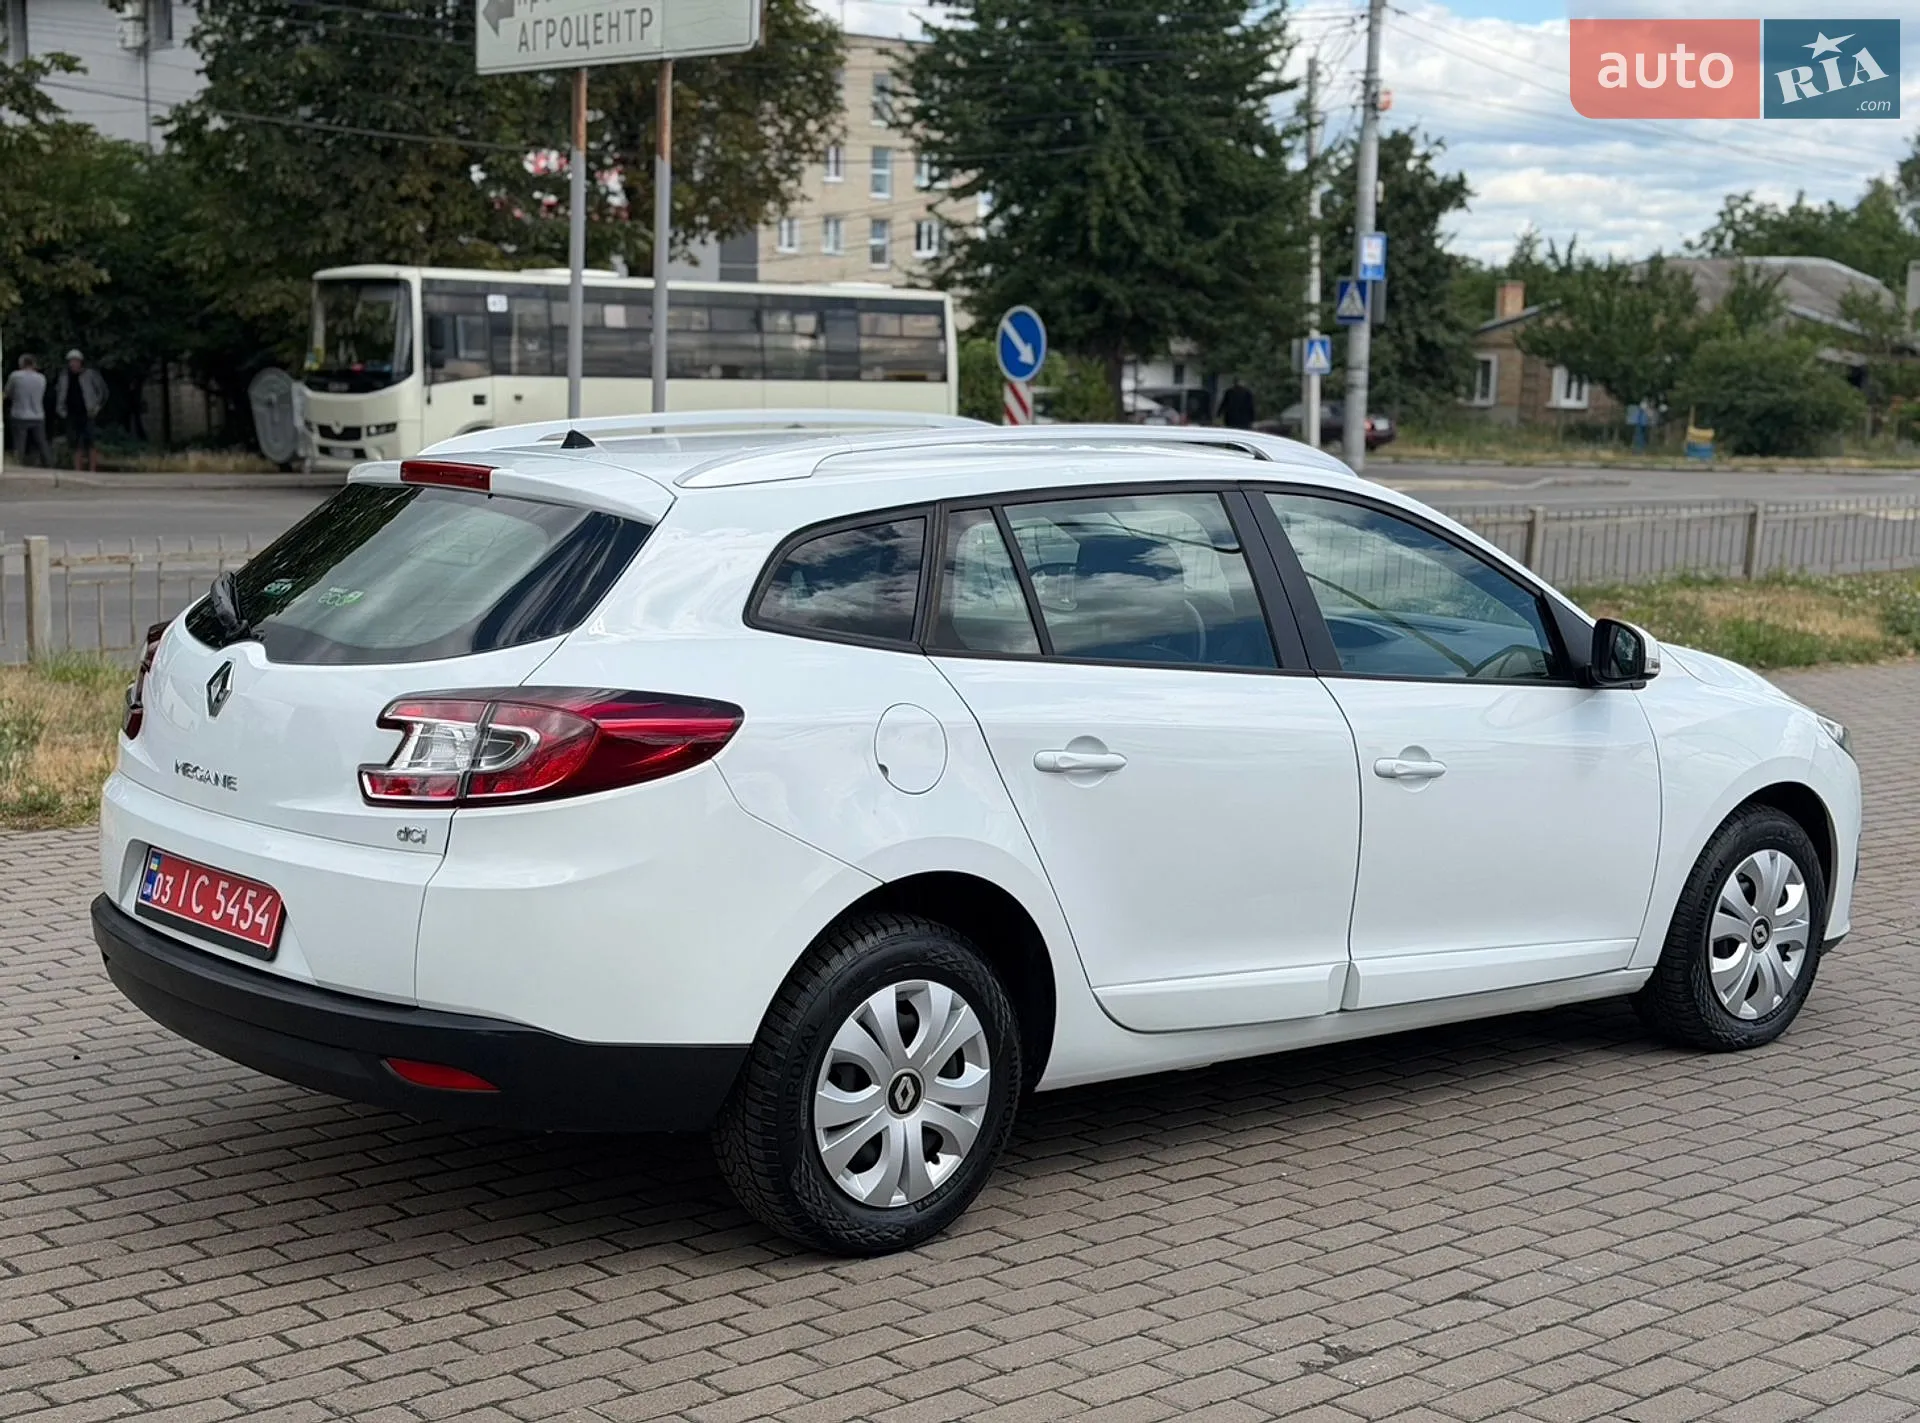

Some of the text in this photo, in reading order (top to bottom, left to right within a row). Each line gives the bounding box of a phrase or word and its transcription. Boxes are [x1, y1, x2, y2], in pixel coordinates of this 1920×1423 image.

[517, 7, 654, 53] АГРОЦЕНТР
[152, 872, 174, 905] 03
[211, 880, 274, 937] 5454
